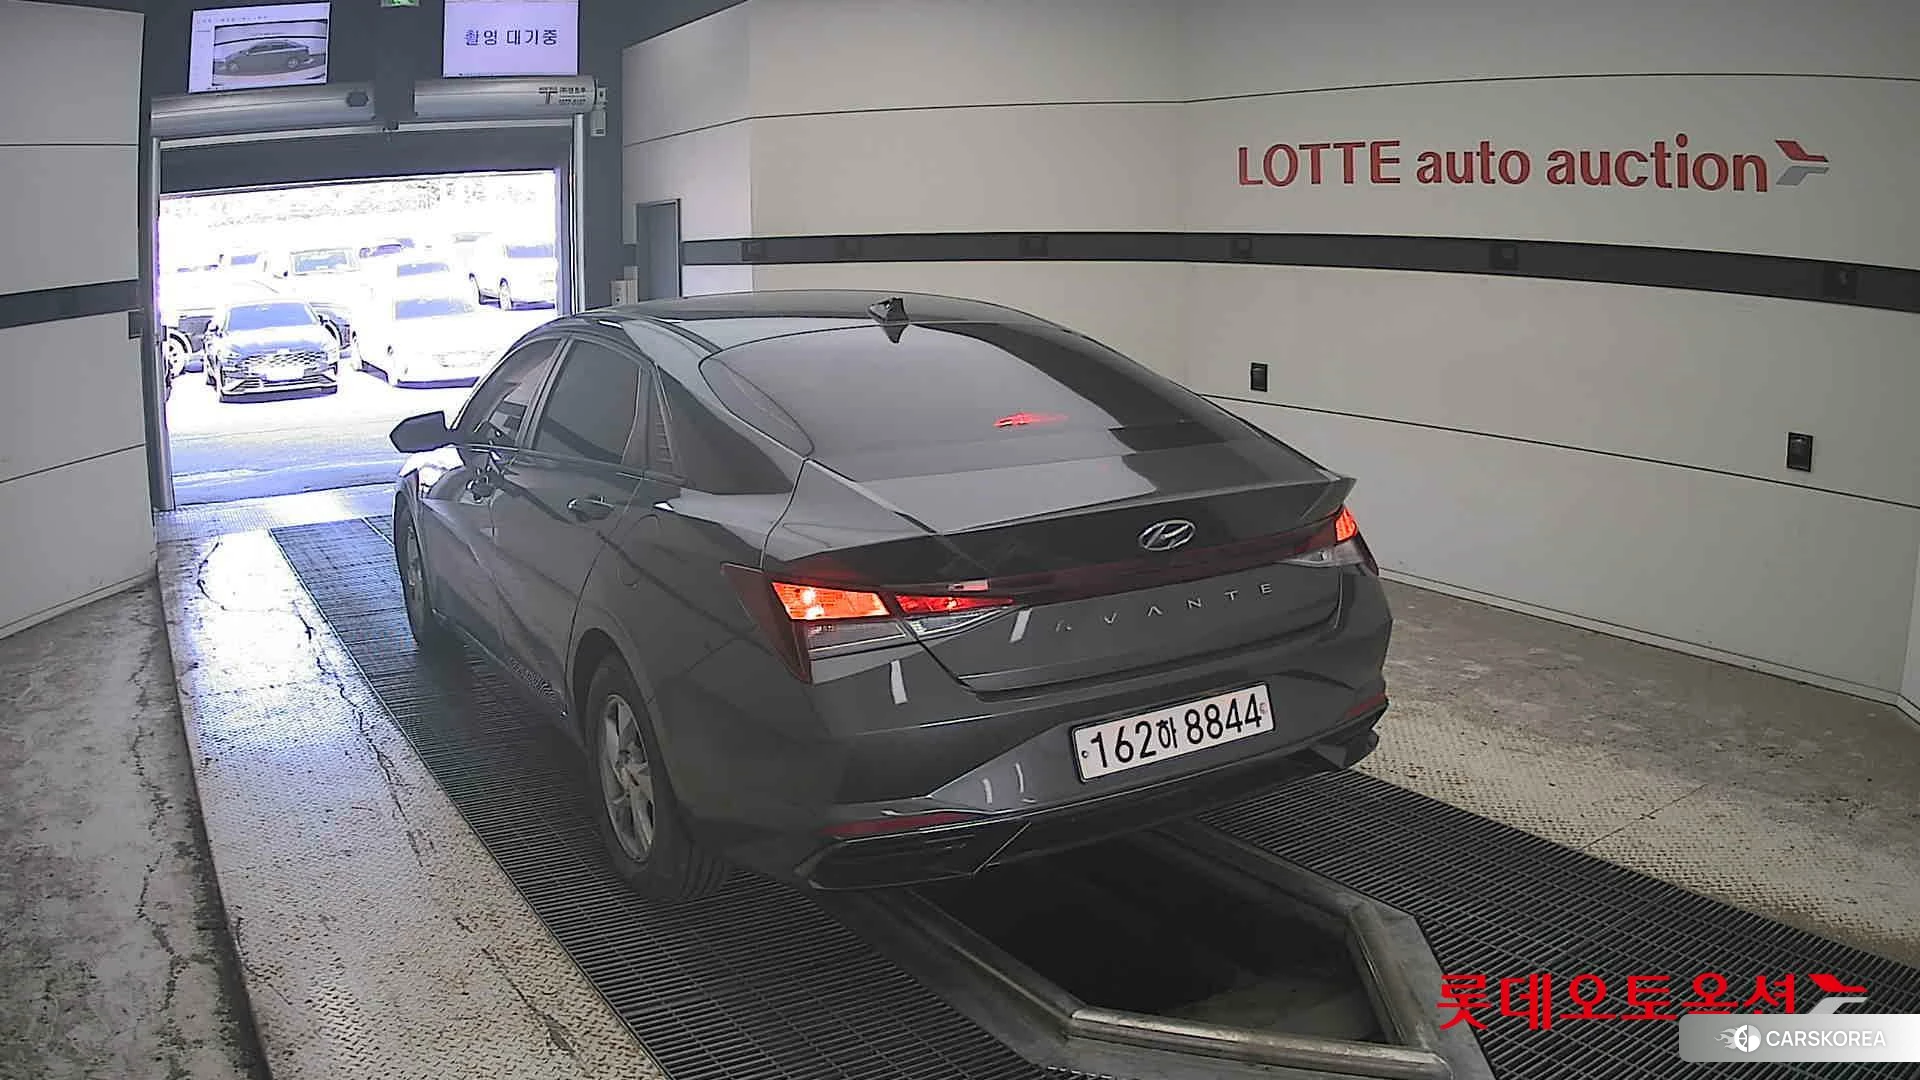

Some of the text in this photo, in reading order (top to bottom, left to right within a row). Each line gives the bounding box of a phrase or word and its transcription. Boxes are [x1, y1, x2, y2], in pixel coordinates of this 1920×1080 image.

[506, 29, 558, 46] 대기중
[1238, 133, 1768, 193] LOTTE auto auction
[1090, 693, 1263, 768] 162하 8844
